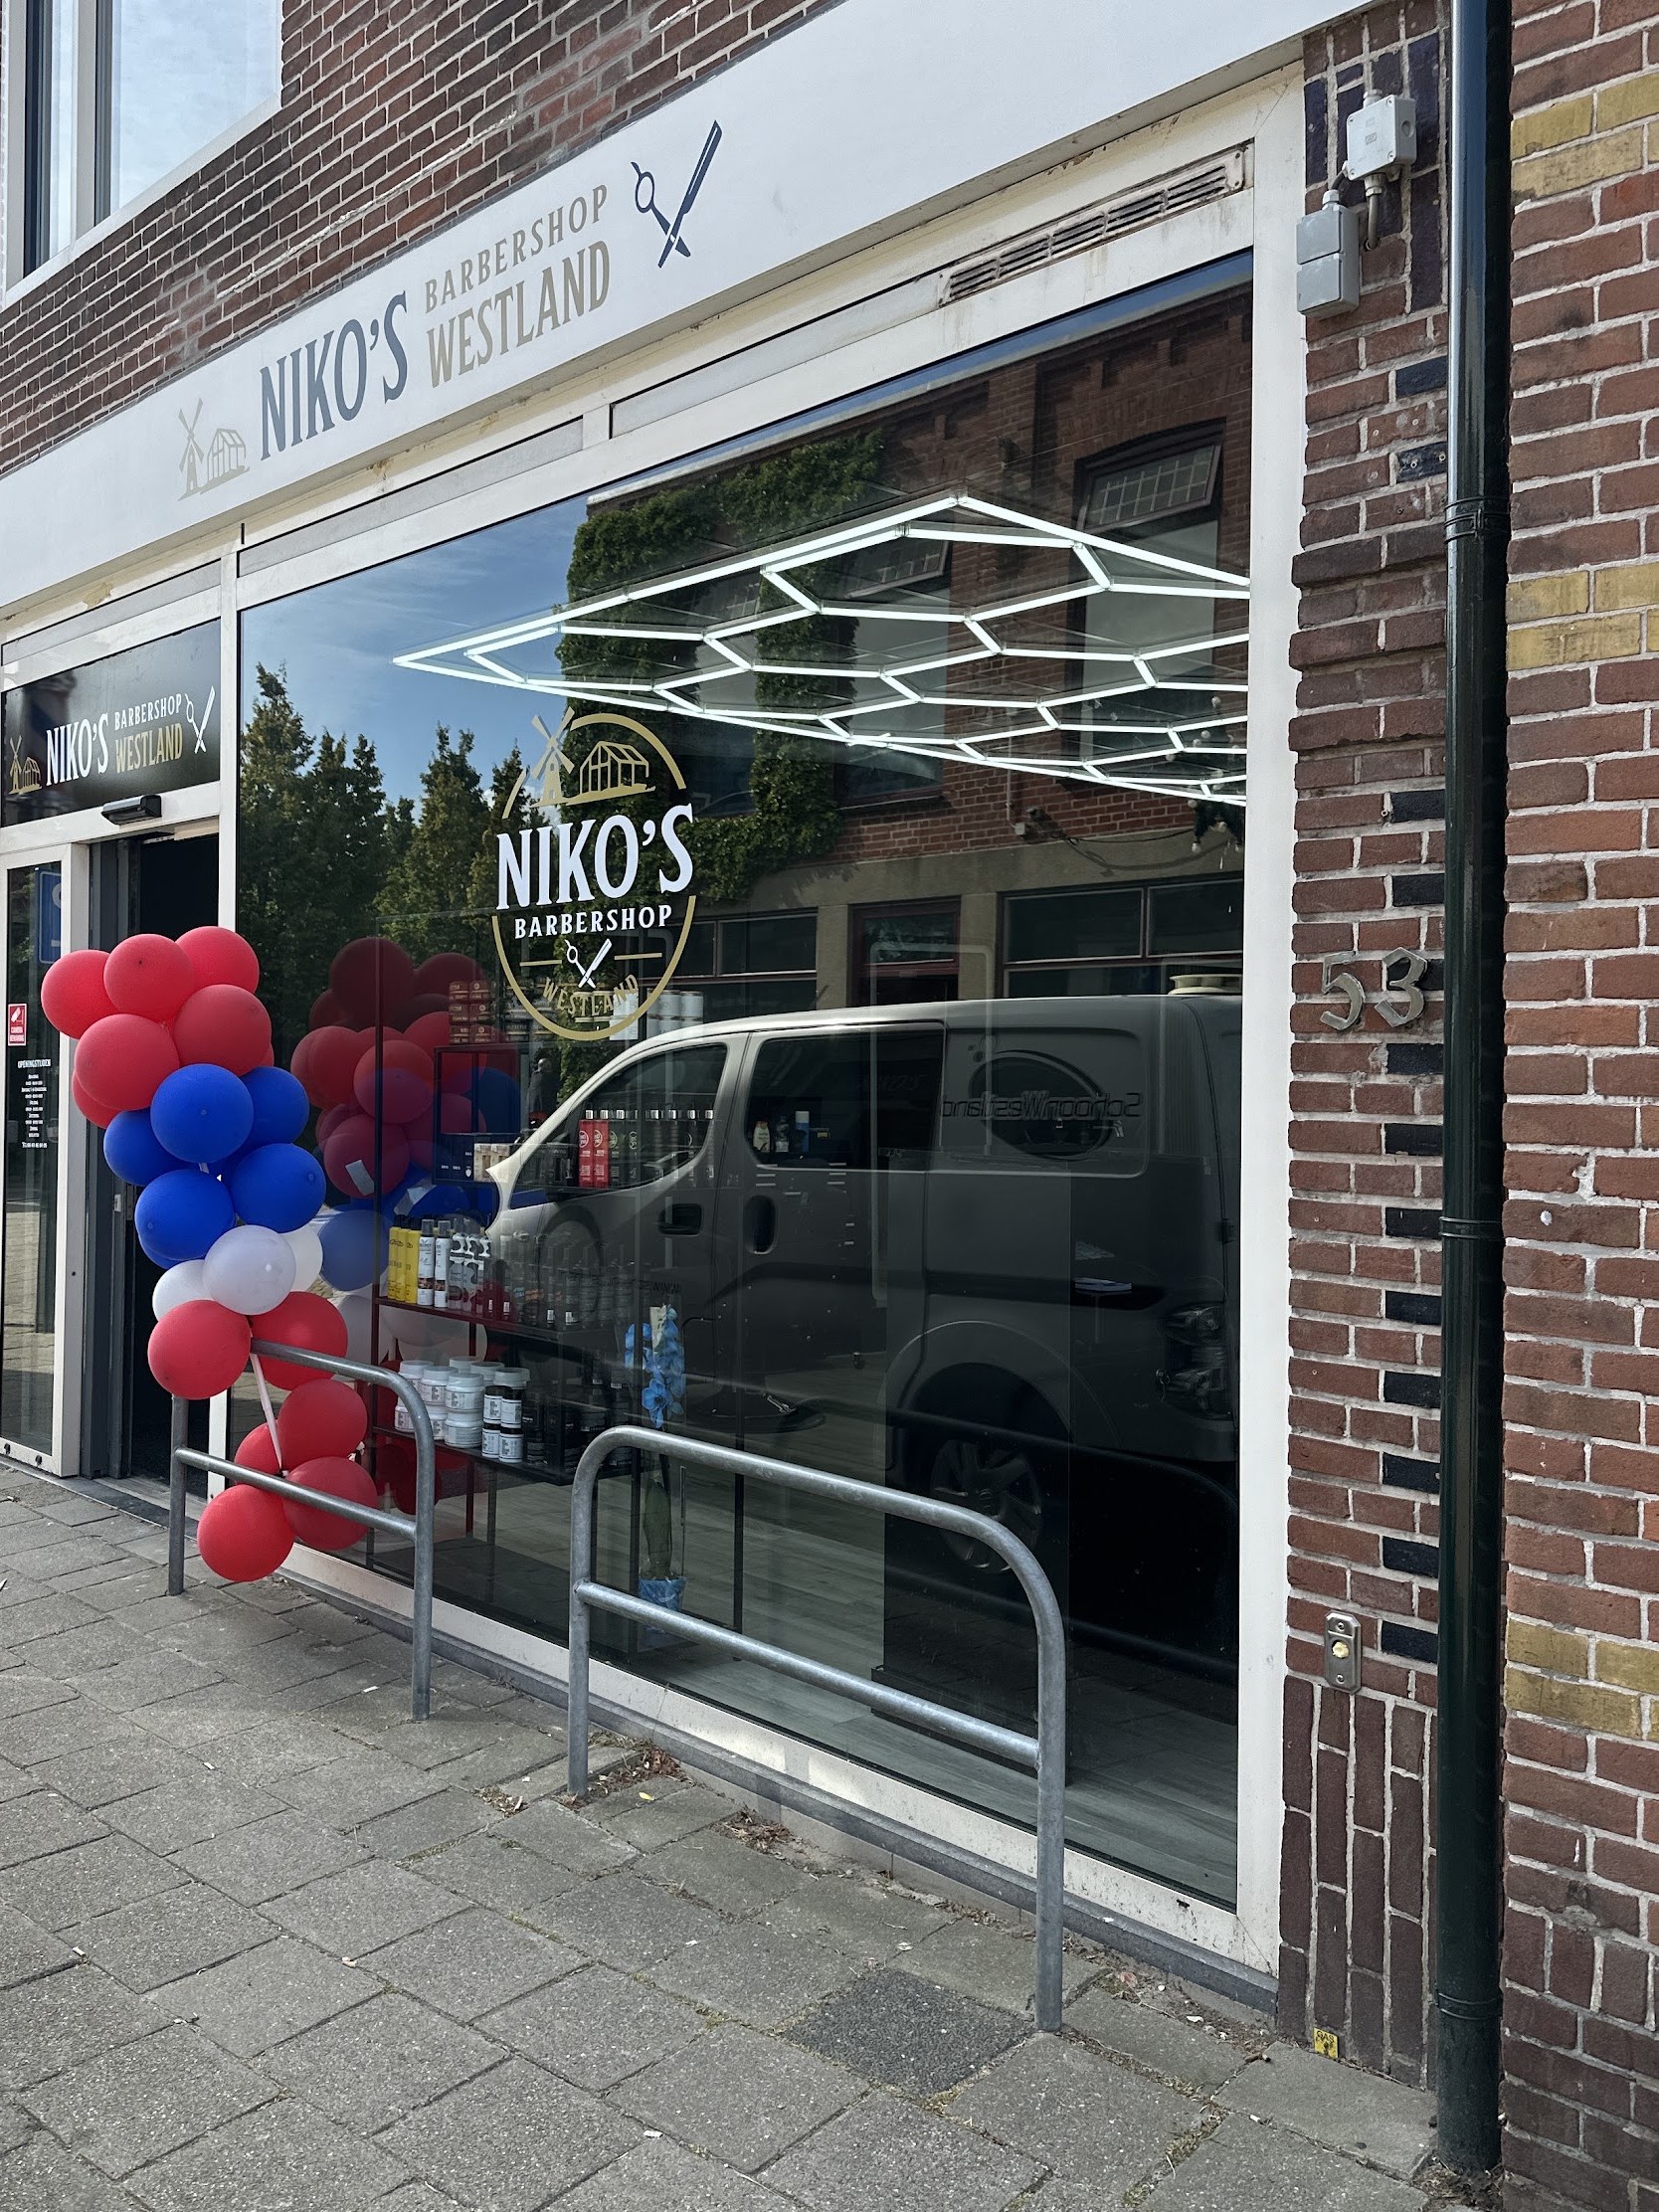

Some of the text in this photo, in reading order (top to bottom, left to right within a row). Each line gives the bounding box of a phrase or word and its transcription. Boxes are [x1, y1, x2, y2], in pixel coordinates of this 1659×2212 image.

[425, 184, 609, 314] BARBERSHOP
[427, 240, 611, 389] WESTLAND
[259, 290, 408, 461] NIKO'S
[46, 712, 109, 787] NIKO'S
[114, 693, 182, 731] BARBERSHOP
[115, 723, 183, 774] WESTLAND
[495, 803, 694, 910] NIKO'S
[514, 904, 672, 939] BARBERSHOP
[542, 973, 640, 1018] WESTLAND
[1319, 946, 1428, 1030] 53
